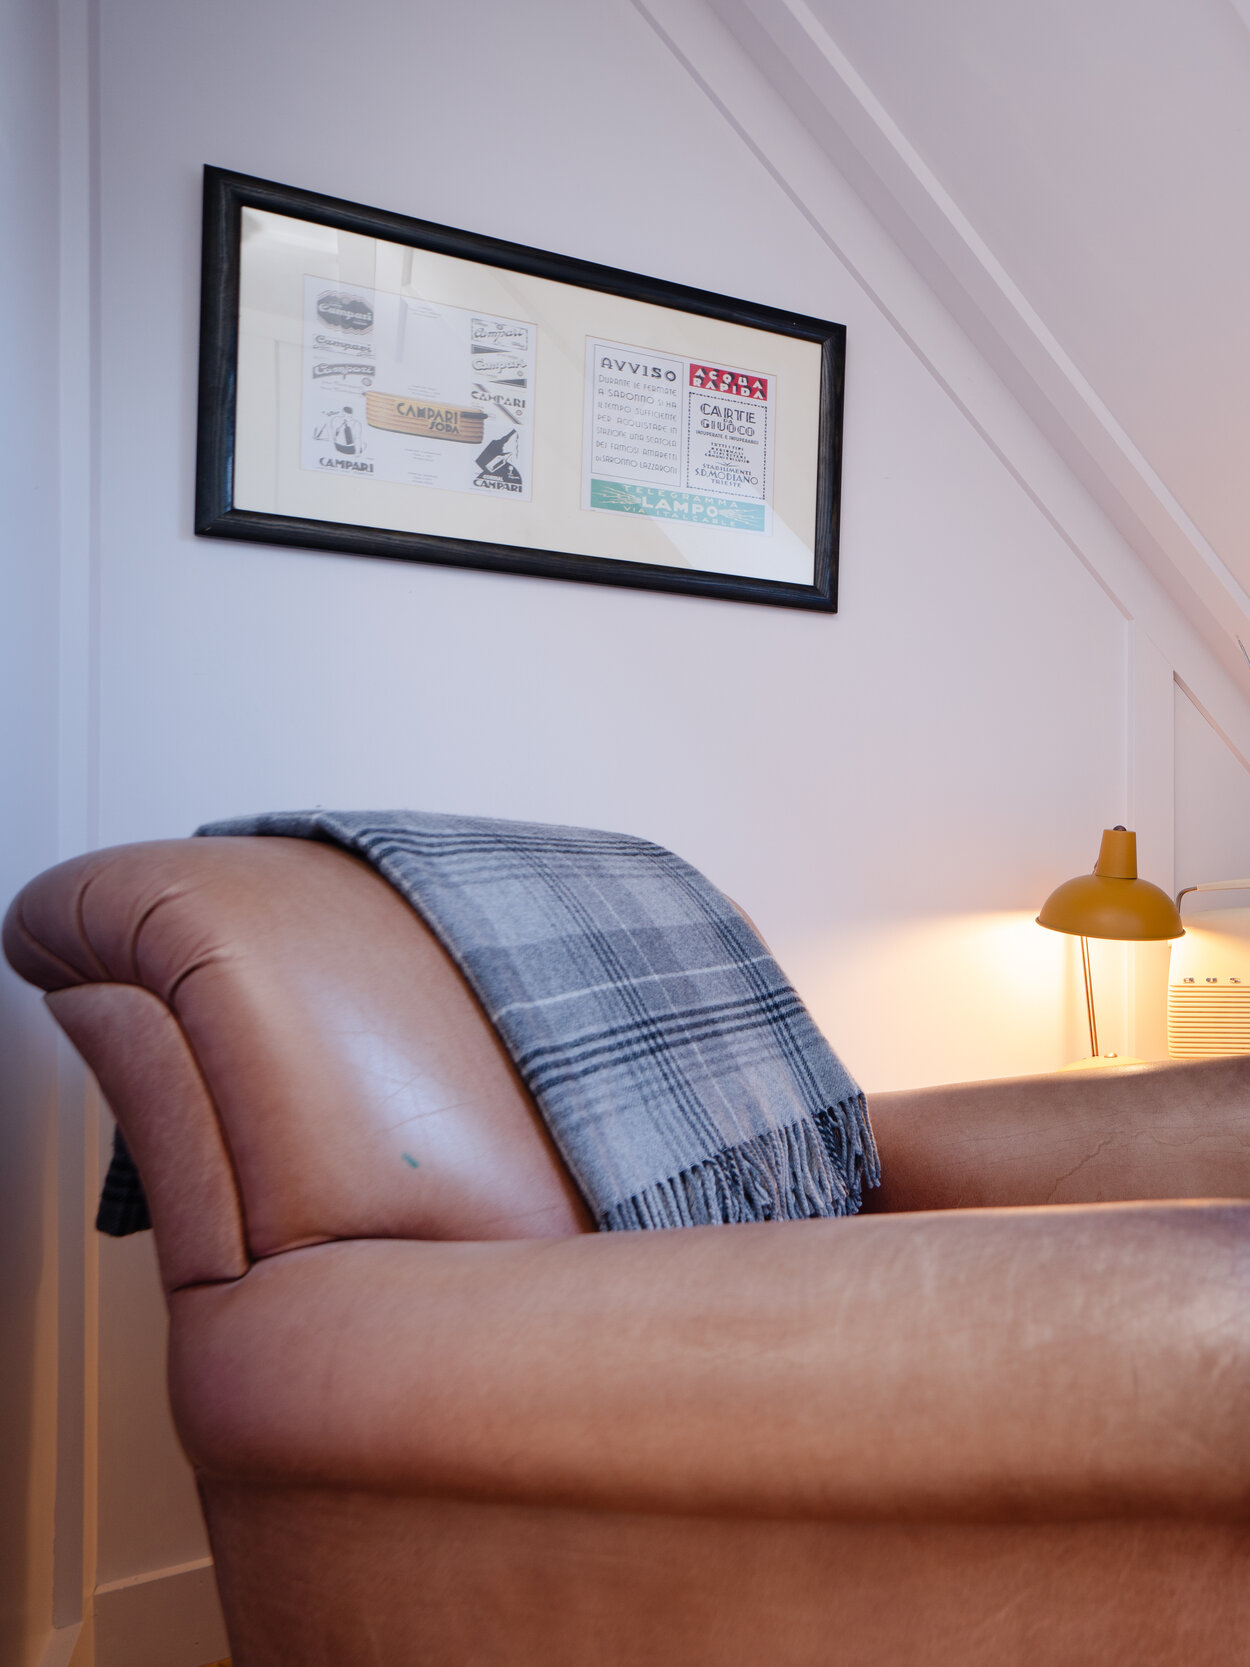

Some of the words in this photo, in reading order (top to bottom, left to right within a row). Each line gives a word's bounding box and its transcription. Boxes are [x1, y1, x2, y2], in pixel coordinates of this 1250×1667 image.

[319, 302, 372, 320] Campari
[600, 357, 676, 381] AVVISO
[694, 368, 764, 389] ACQUA
[608, 389, 654, 404] SARONNO
[643, 383, 677, 396] FERMATE
[693, 378, 765, 399] RAPIDA
[471, 391, 526, 408] CAMPARI
[397, 403, 458, 424] CAMPARI
[603, 402, 631, 413] TEMPO
[635, 408, 677, 422] SUFFICIENTE
[701, 403, 756, 424] CARTE
[429, 422, 460, 434] SODA
[597, 414, 611, 422] PER
[617, 417, 668, 432] ACQUISTARE
[670, 426, 677, 434] IN
[701, 419, 755, 436] GIUOCO
[596, 426, 627, 438] STAZIONE
[629, 433, 644, 441] UNA
[646, 435, 677, 447] SCATOLA
[596, 440, 607, 448] DEI
[610, 442, 639, 454] FAMOSI
[642, 448, 677, 460] AMARETTI
[319, 457, 374, 473] CAMPARI
[602, 455, 638, 467] SARONNO
[639, 461, 677, 474] LAZZARONI
[702, 463, 751, 476] STABILIMENTI
[473, 479, 523, 493] CAMPARI
[711, 478, 741, 488] TRIESTE
[623, 484, 739, 508] TELEGRAMMA
[641, 495, 719, 517] LAMPO
[623, 505, 646, 513] VIA
[656, 509, 736, 527] ITALCABLE
